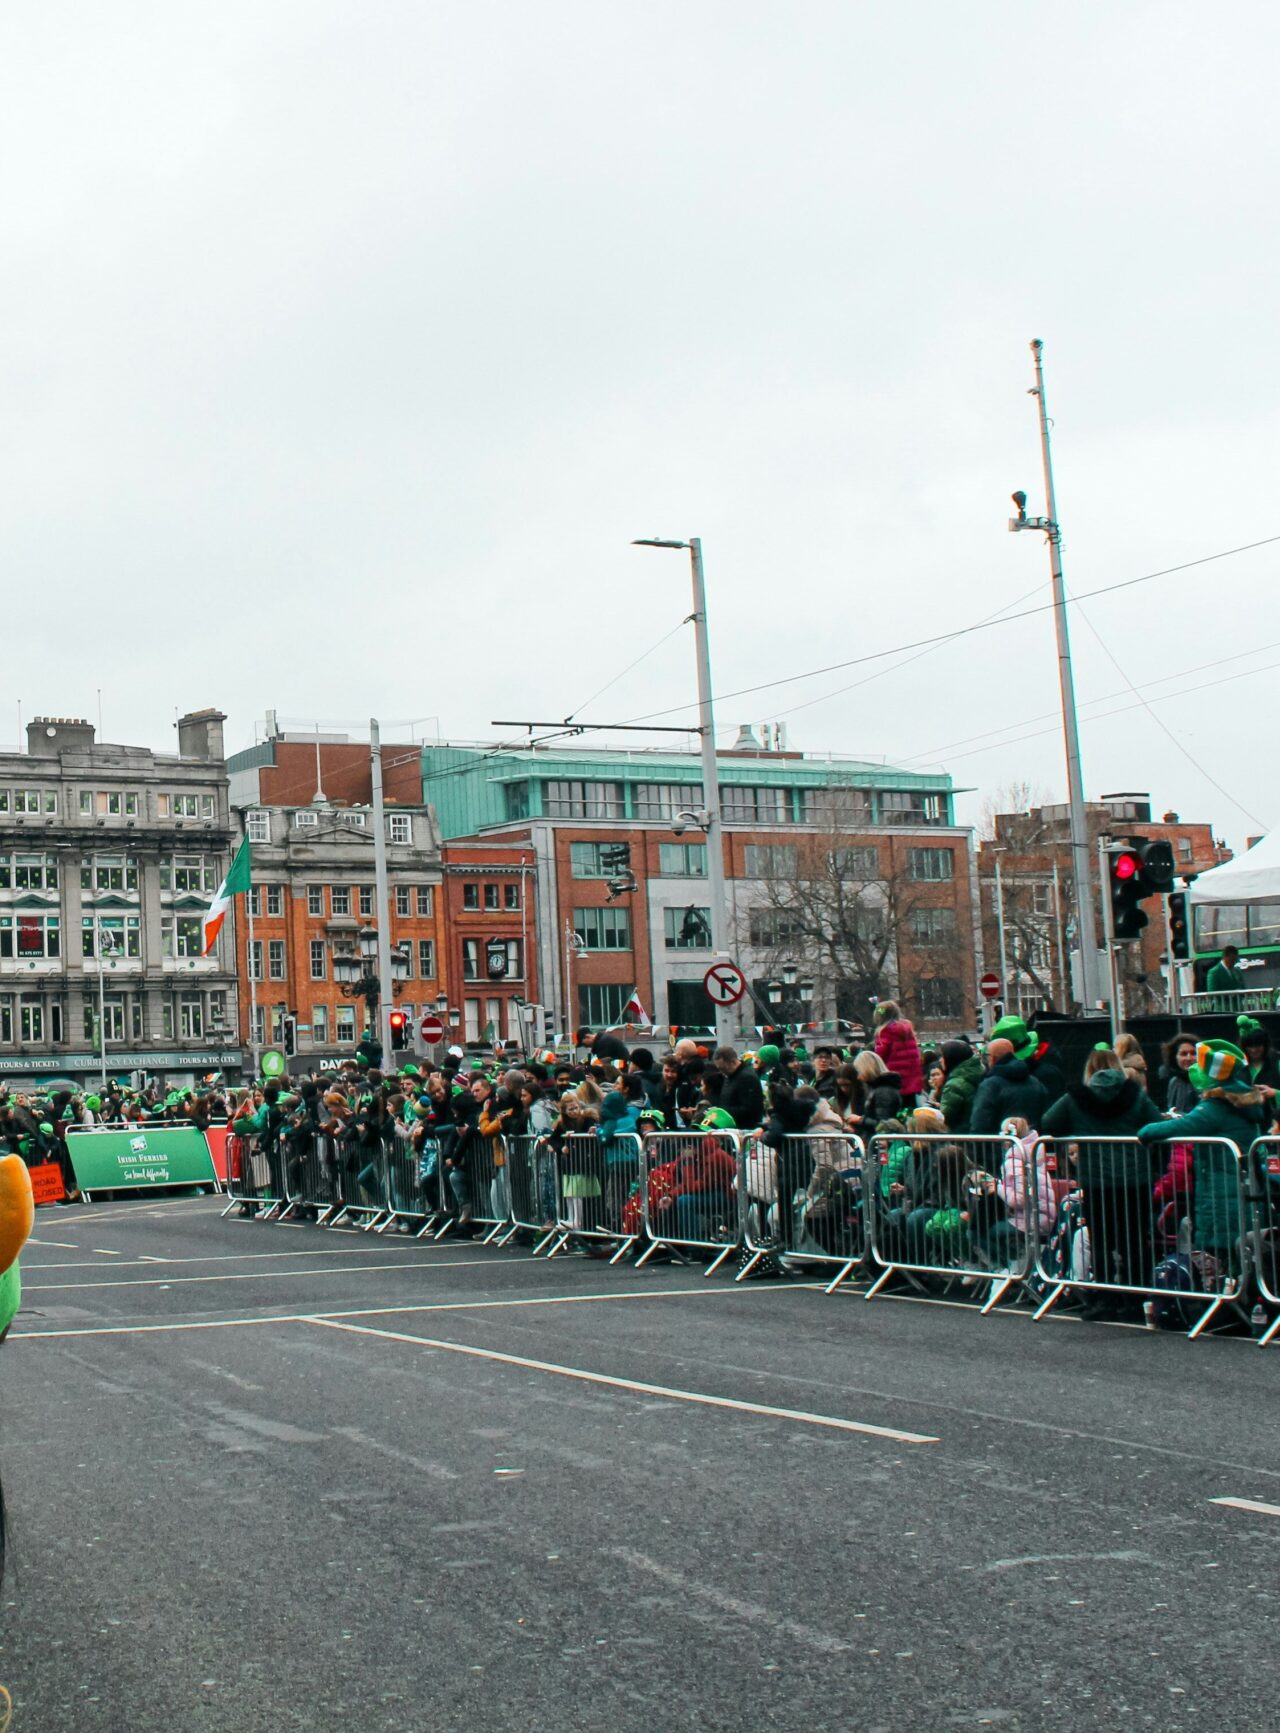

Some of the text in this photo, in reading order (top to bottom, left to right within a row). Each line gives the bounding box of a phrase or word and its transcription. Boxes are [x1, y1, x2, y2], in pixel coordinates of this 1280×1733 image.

[0, 1061, 23, 1069] TOURS
[31, 1060, 60, 1068] TICKETS
[74, 1057, 169, 1067] CURRENCY EXCHANGE
[179, 1057, 201, 1065] TOURS
[201, 1056, 208, 1064] &
[320, 1058, 358, 1071] DAY
[117, 1155, 137, 1164] IRISH
[34, 1177, 57, 1187] ROAD
